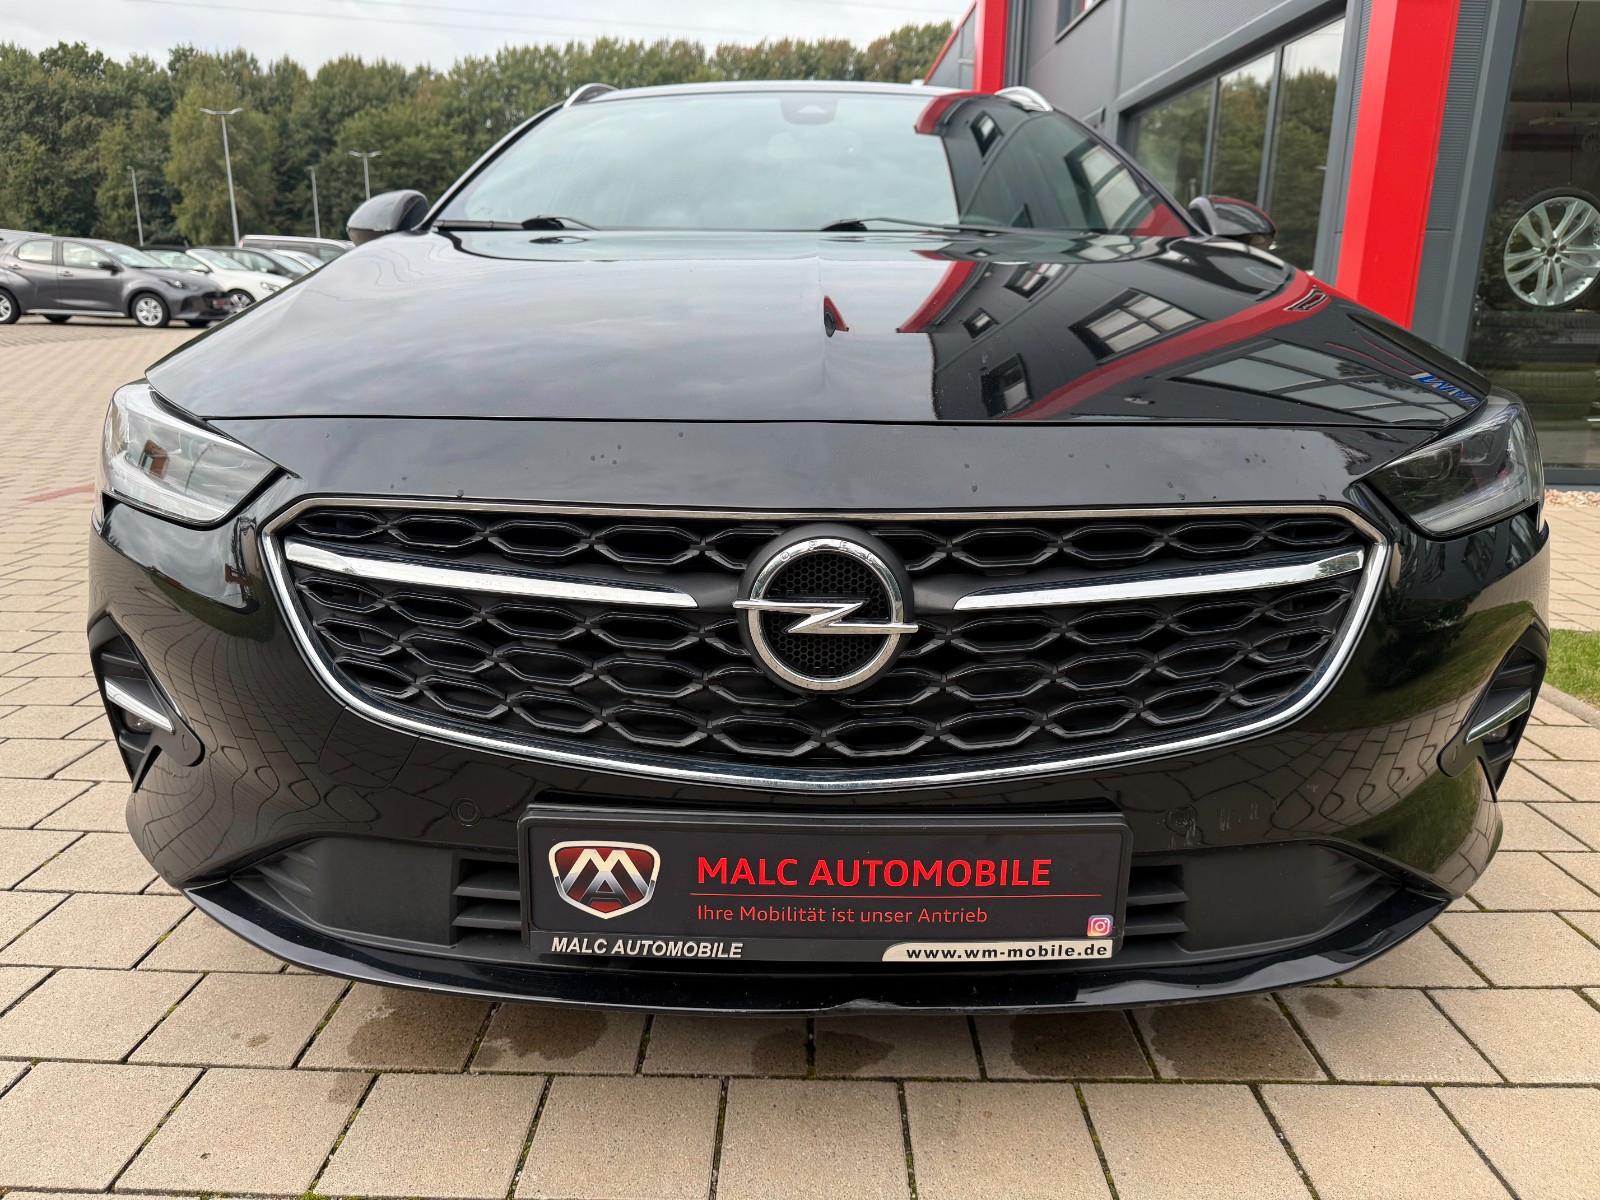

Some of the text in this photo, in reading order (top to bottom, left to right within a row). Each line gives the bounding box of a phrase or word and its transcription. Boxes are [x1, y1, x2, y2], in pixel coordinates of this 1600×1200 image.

[697, 856, 1053, 888] MALC AUTOMOBILE
[697, 904, 989, 924] Ihre Mobilität ist unser Antrieb
[551, 937, 744, 958] MALC AUTOMOBILE
[906, 943, 1108, 960] www.wm-mobile.de
